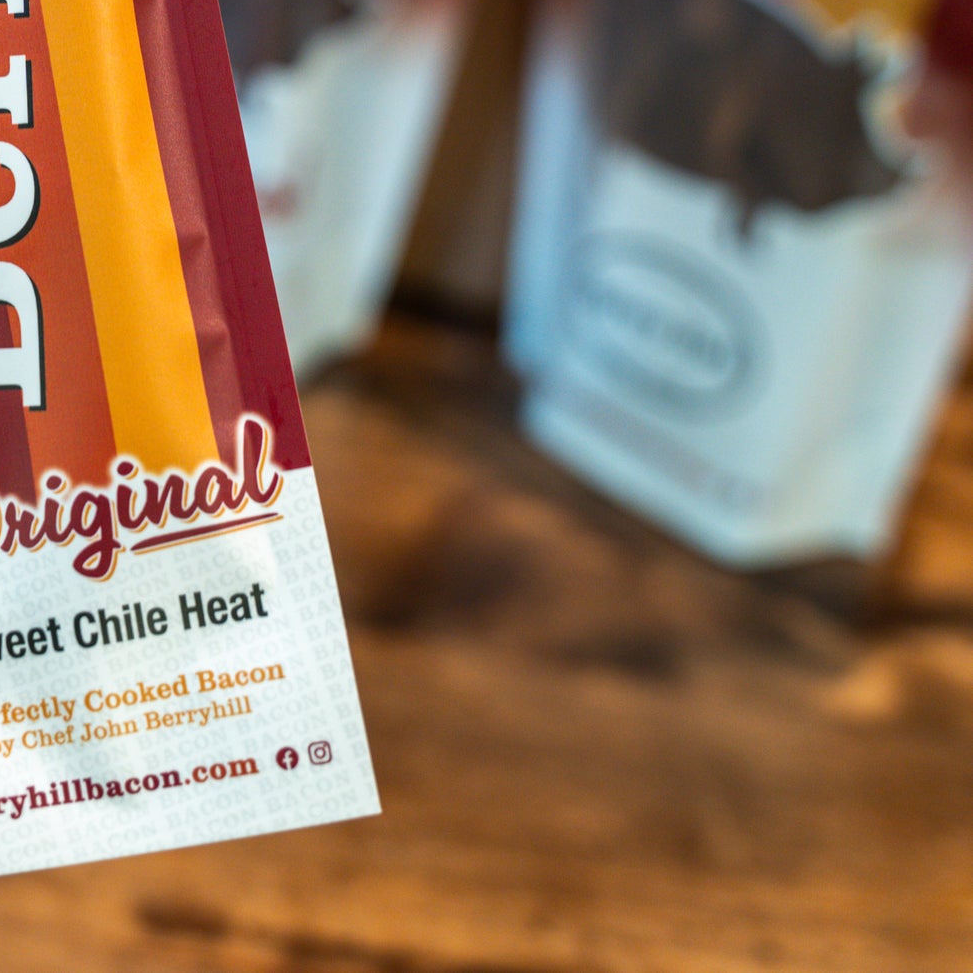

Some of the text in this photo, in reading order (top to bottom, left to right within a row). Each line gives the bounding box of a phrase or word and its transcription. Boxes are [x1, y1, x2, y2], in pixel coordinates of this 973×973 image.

[72, 602, 168, 649] Chile
[179, 583, 268, 629] Heat
[83, 675, 189, 713] Cooked
[195, 661, 286, 695] Bacon
[21, 727, 77, 751] Chef
[81, 719, 139, 745] John
[145, 695, 253, 732] Berryhill
